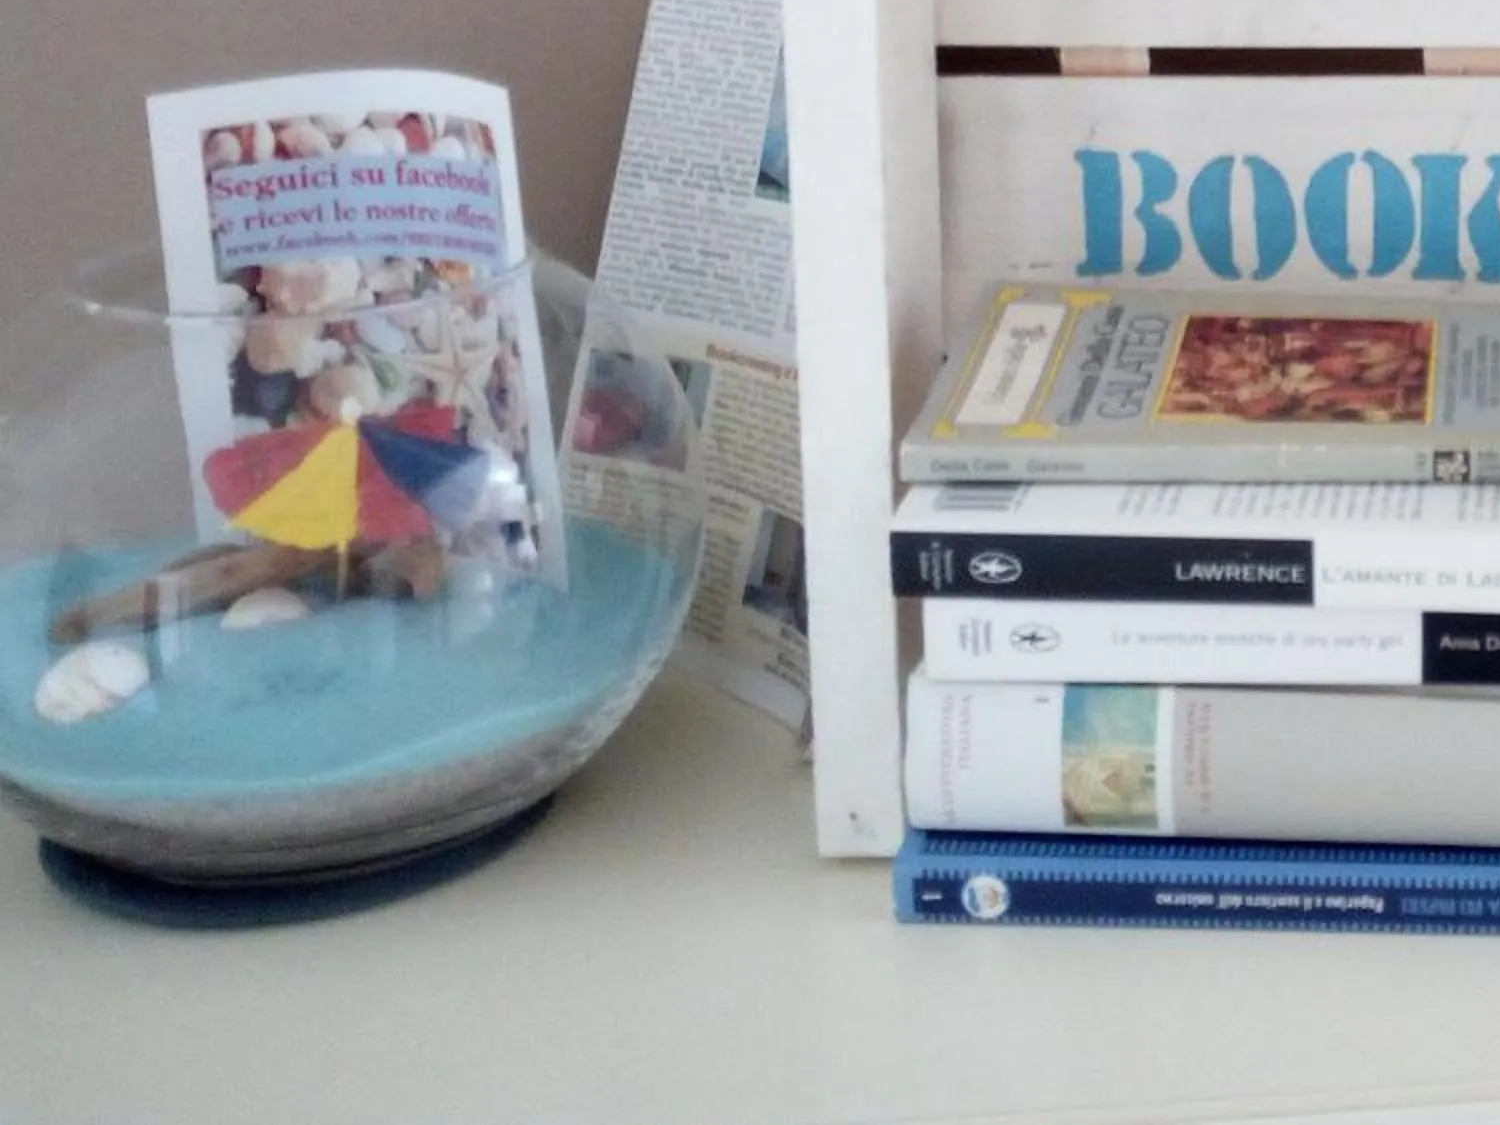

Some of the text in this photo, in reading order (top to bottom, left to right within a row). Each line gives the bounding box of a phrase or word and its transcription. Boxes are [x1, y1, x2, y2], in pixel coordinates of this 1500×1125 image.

[213, 159, 490, 202] Seguici su facebook
[244, 202, 323, 232] ricevi
[333, 195, 358, 222] le
[365, 202, 442, 223] nostre
[1175, 562, 1306, 585] LAWRENCE
[1322, 569, 1427, 588] L'AMANTE
[1438, 572, 1458, 588] DI
[1439, 635, 1481, 652] Anna
